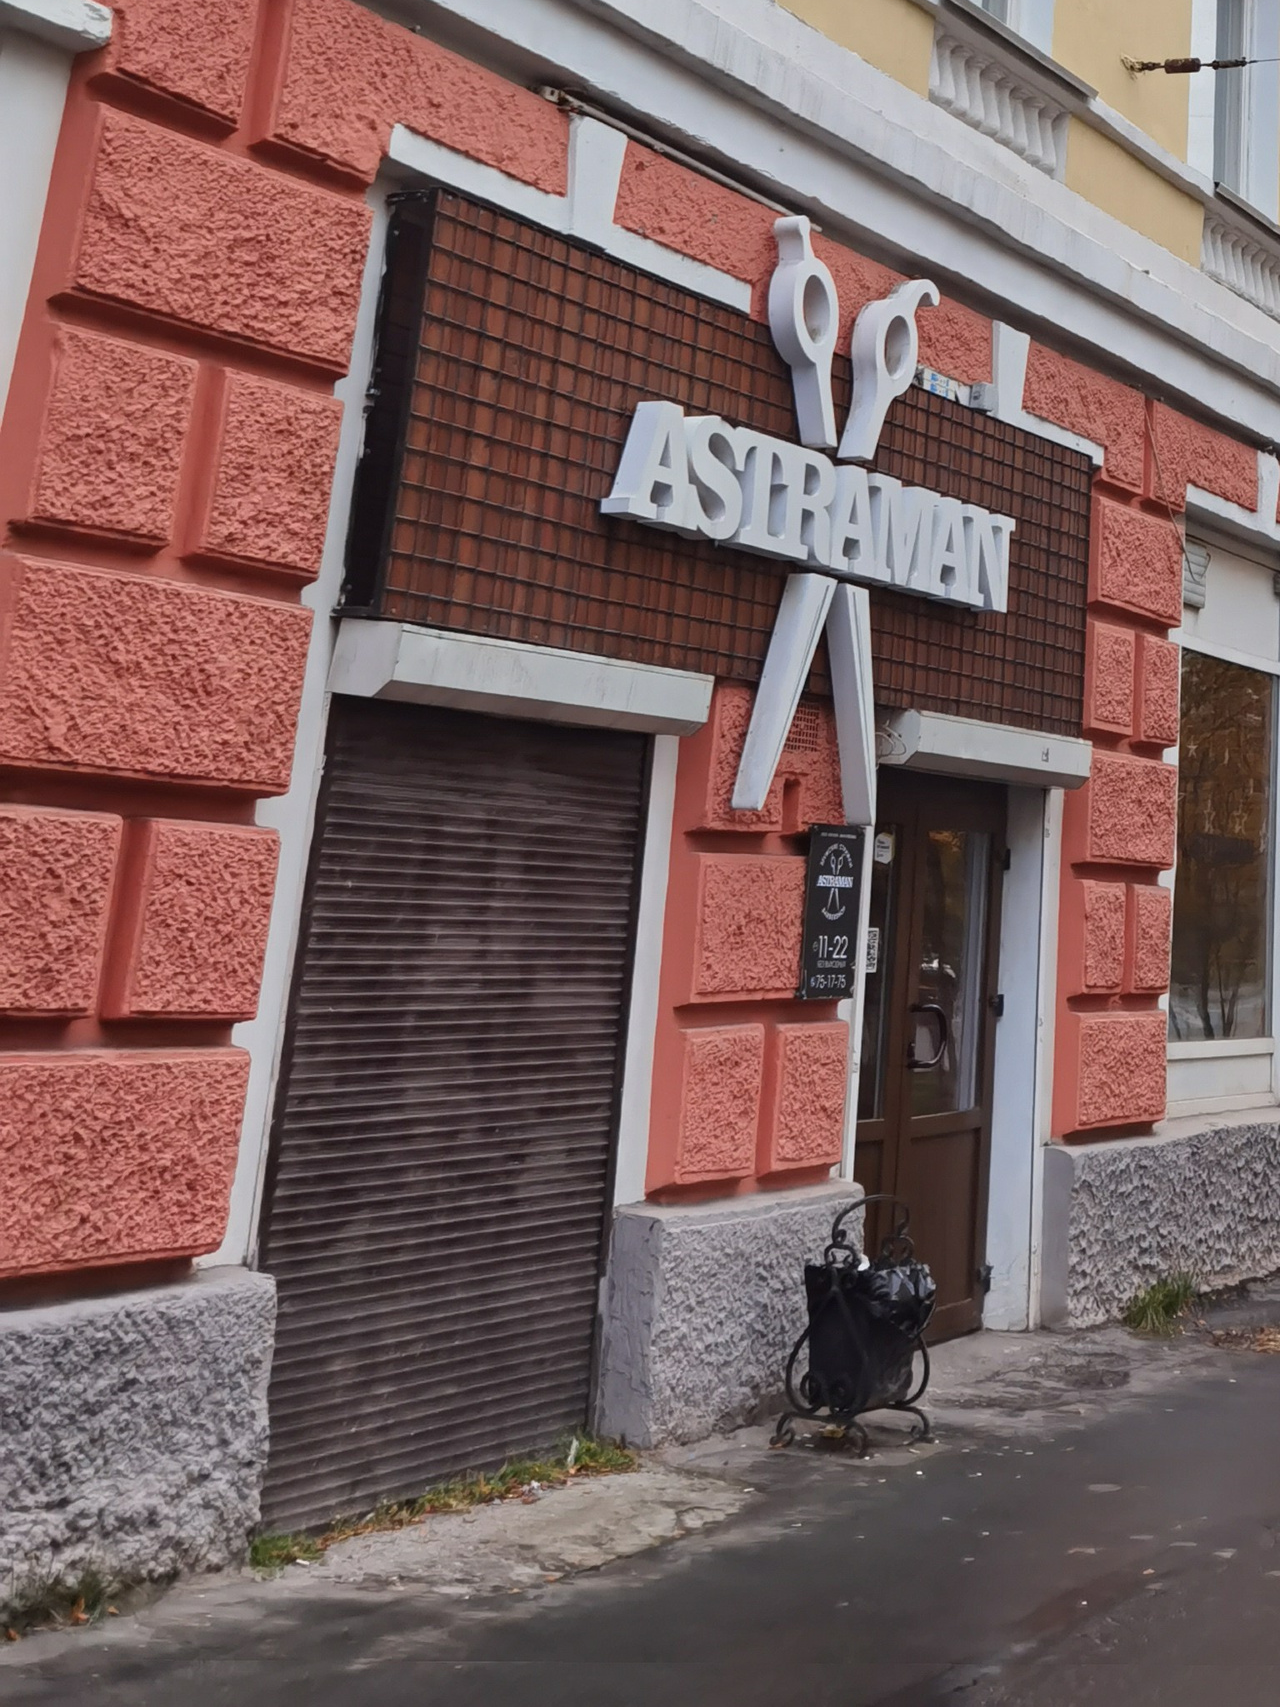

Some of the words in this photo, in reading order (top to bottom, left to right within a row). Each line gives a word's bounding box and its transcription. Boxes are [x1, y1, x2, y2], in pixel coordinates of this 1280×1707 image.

[601, 401, 1016, 613] ASTRAMAN
[816, 874, 854, 888] ASTRAMAN
[818, 935, 848, 959] 11-22
[815, 974, 846, 989] 75-17-75
